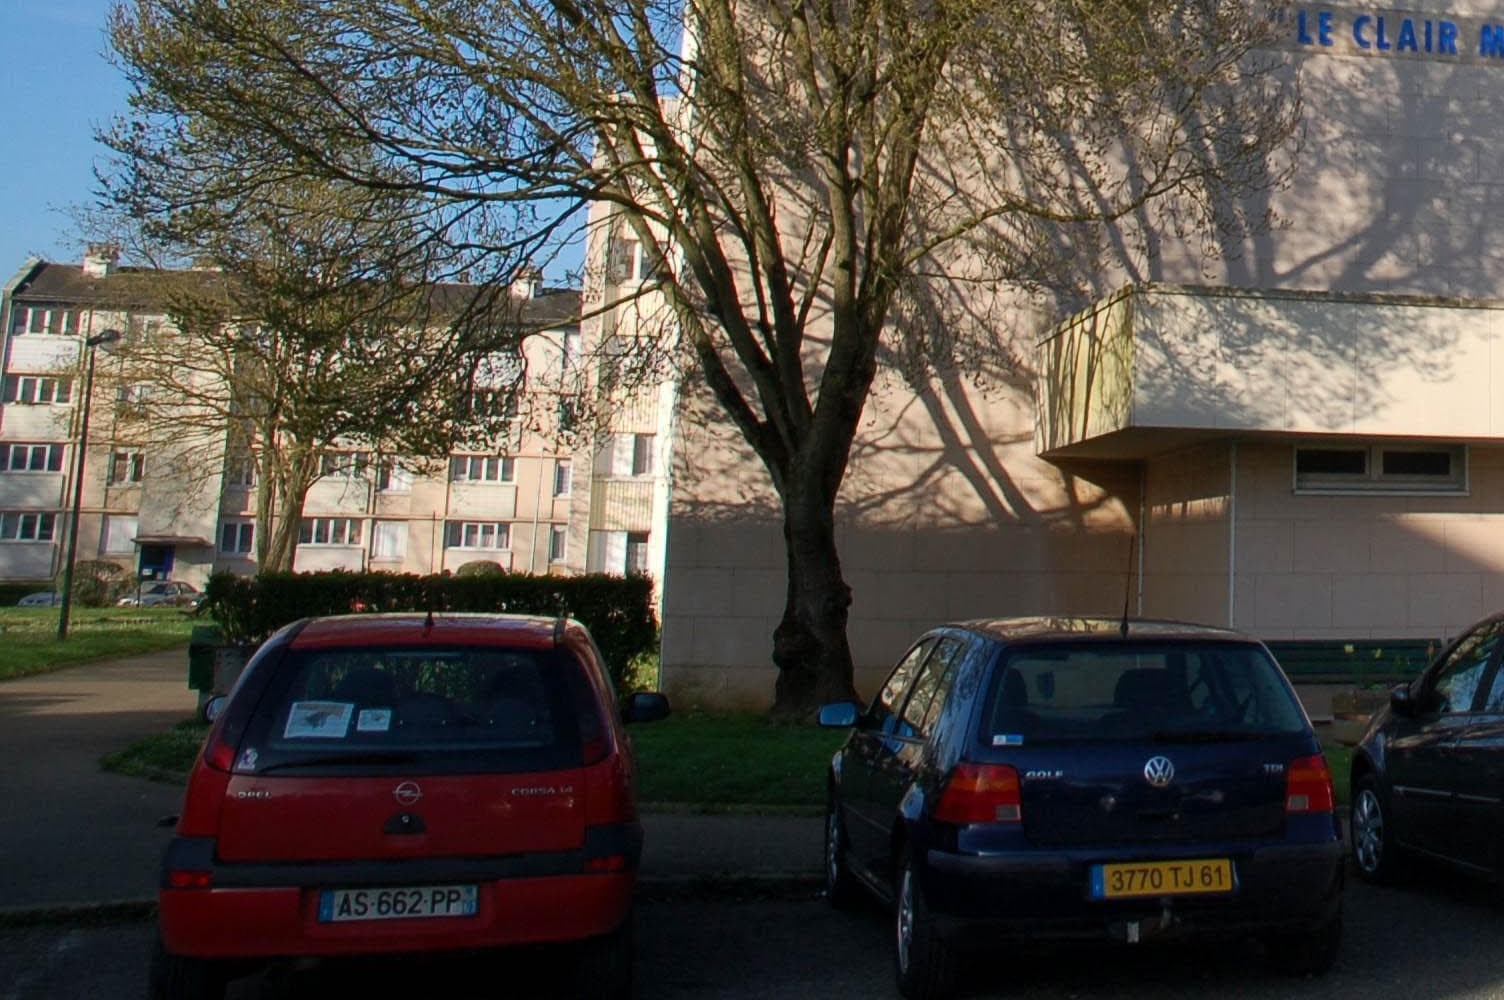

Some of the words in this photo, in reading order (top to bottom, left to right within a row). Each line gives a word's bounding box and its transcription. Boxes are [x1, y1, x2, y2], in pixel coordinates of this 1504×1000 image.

[1297, 9, 1334, 47] LE
[1353, 14, 1458, 56] CLAIR
[1112, 868, 1162, 891] 3770
[1168, 866, 1194, 887] TJ
[1201, 865, 1223, 886] 61
